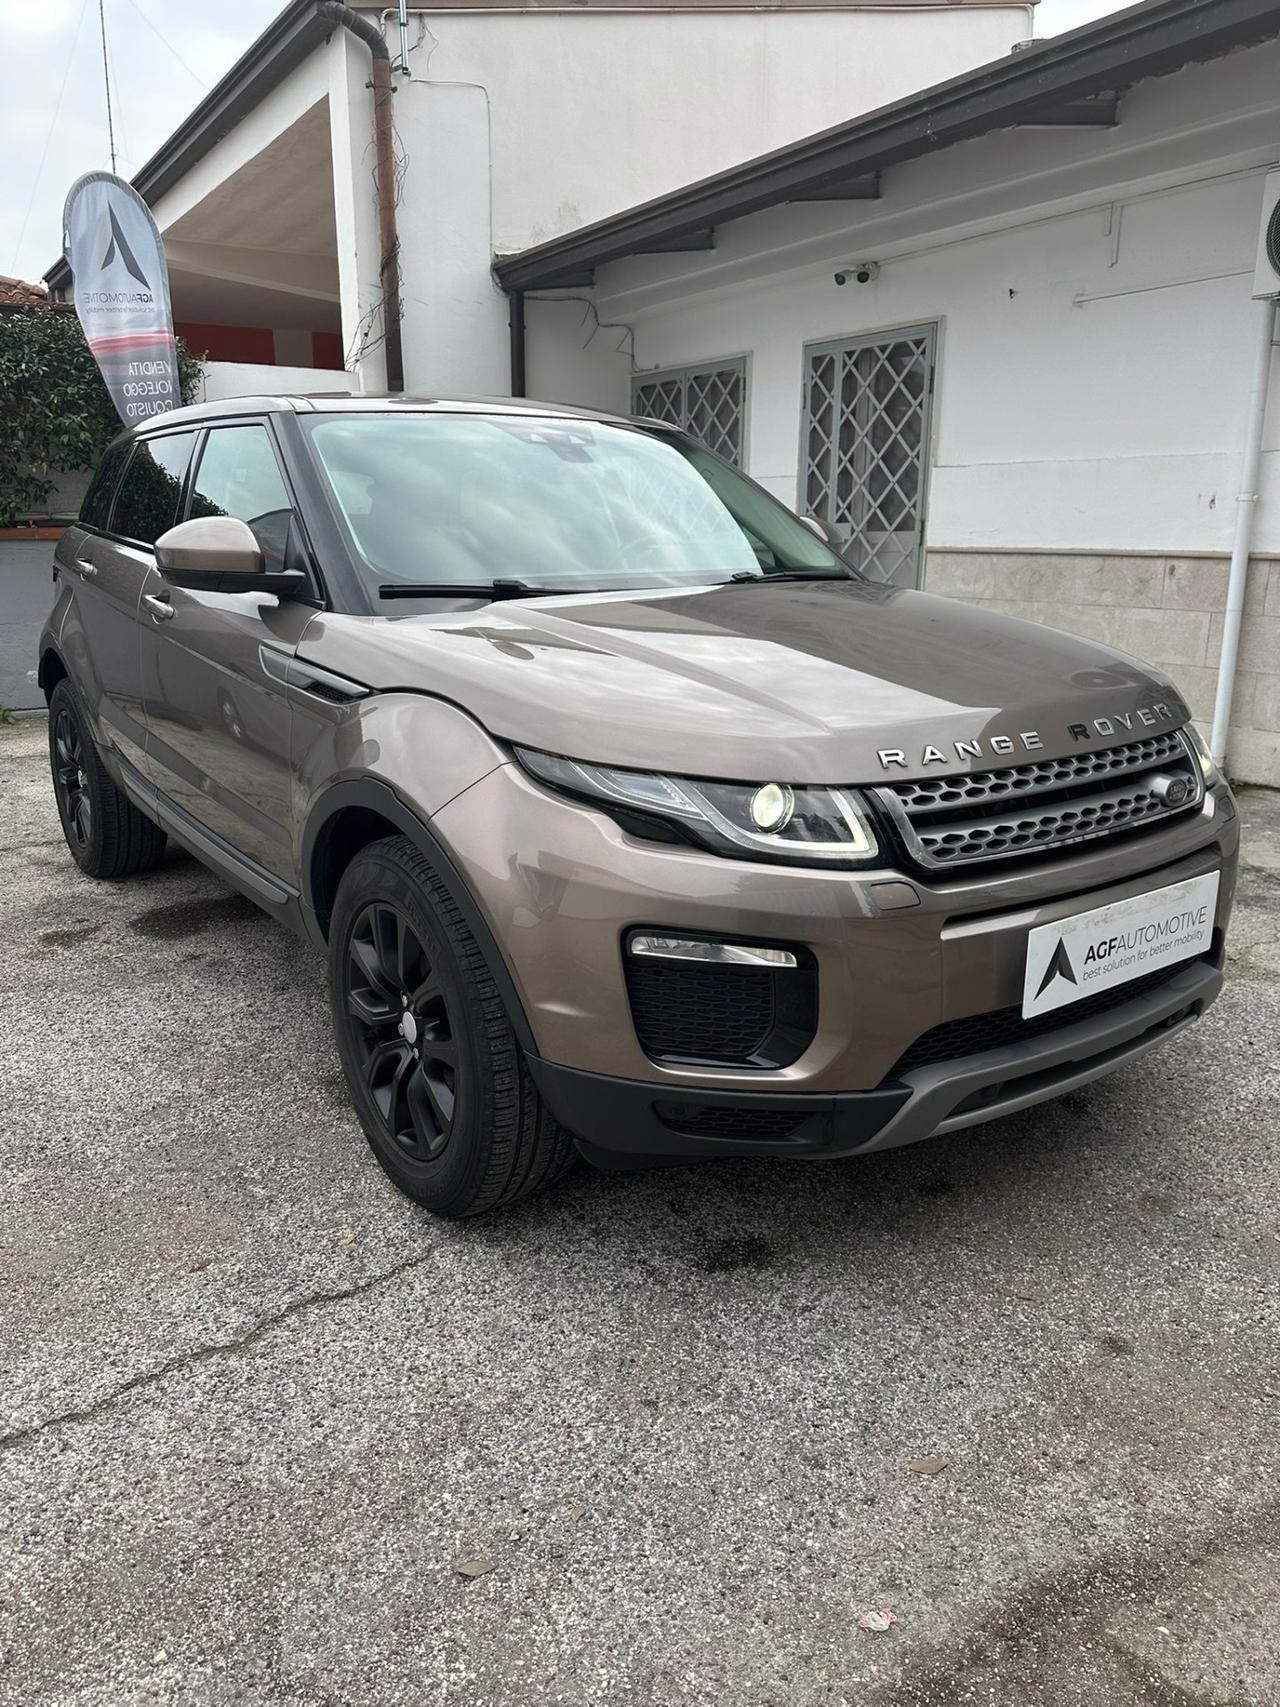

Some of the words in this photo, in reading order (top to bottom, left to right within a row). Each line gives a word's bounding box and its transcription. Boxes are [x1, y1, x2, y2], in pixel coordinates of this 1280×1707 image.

[877, 731, 1044, 770] RANGE
[1067, 703, 1173, 743] ROVER
[1082, 966, 1102, 981] best
[1103, 954, 1136, 975] solution
[1137, 949, 1149, 961] for
[1149, 939, 1174, 957] better
[1173, 929, 1205, 947] mobility
[1083, 905, 1208, 966] AGFAUTOMOTIVE
